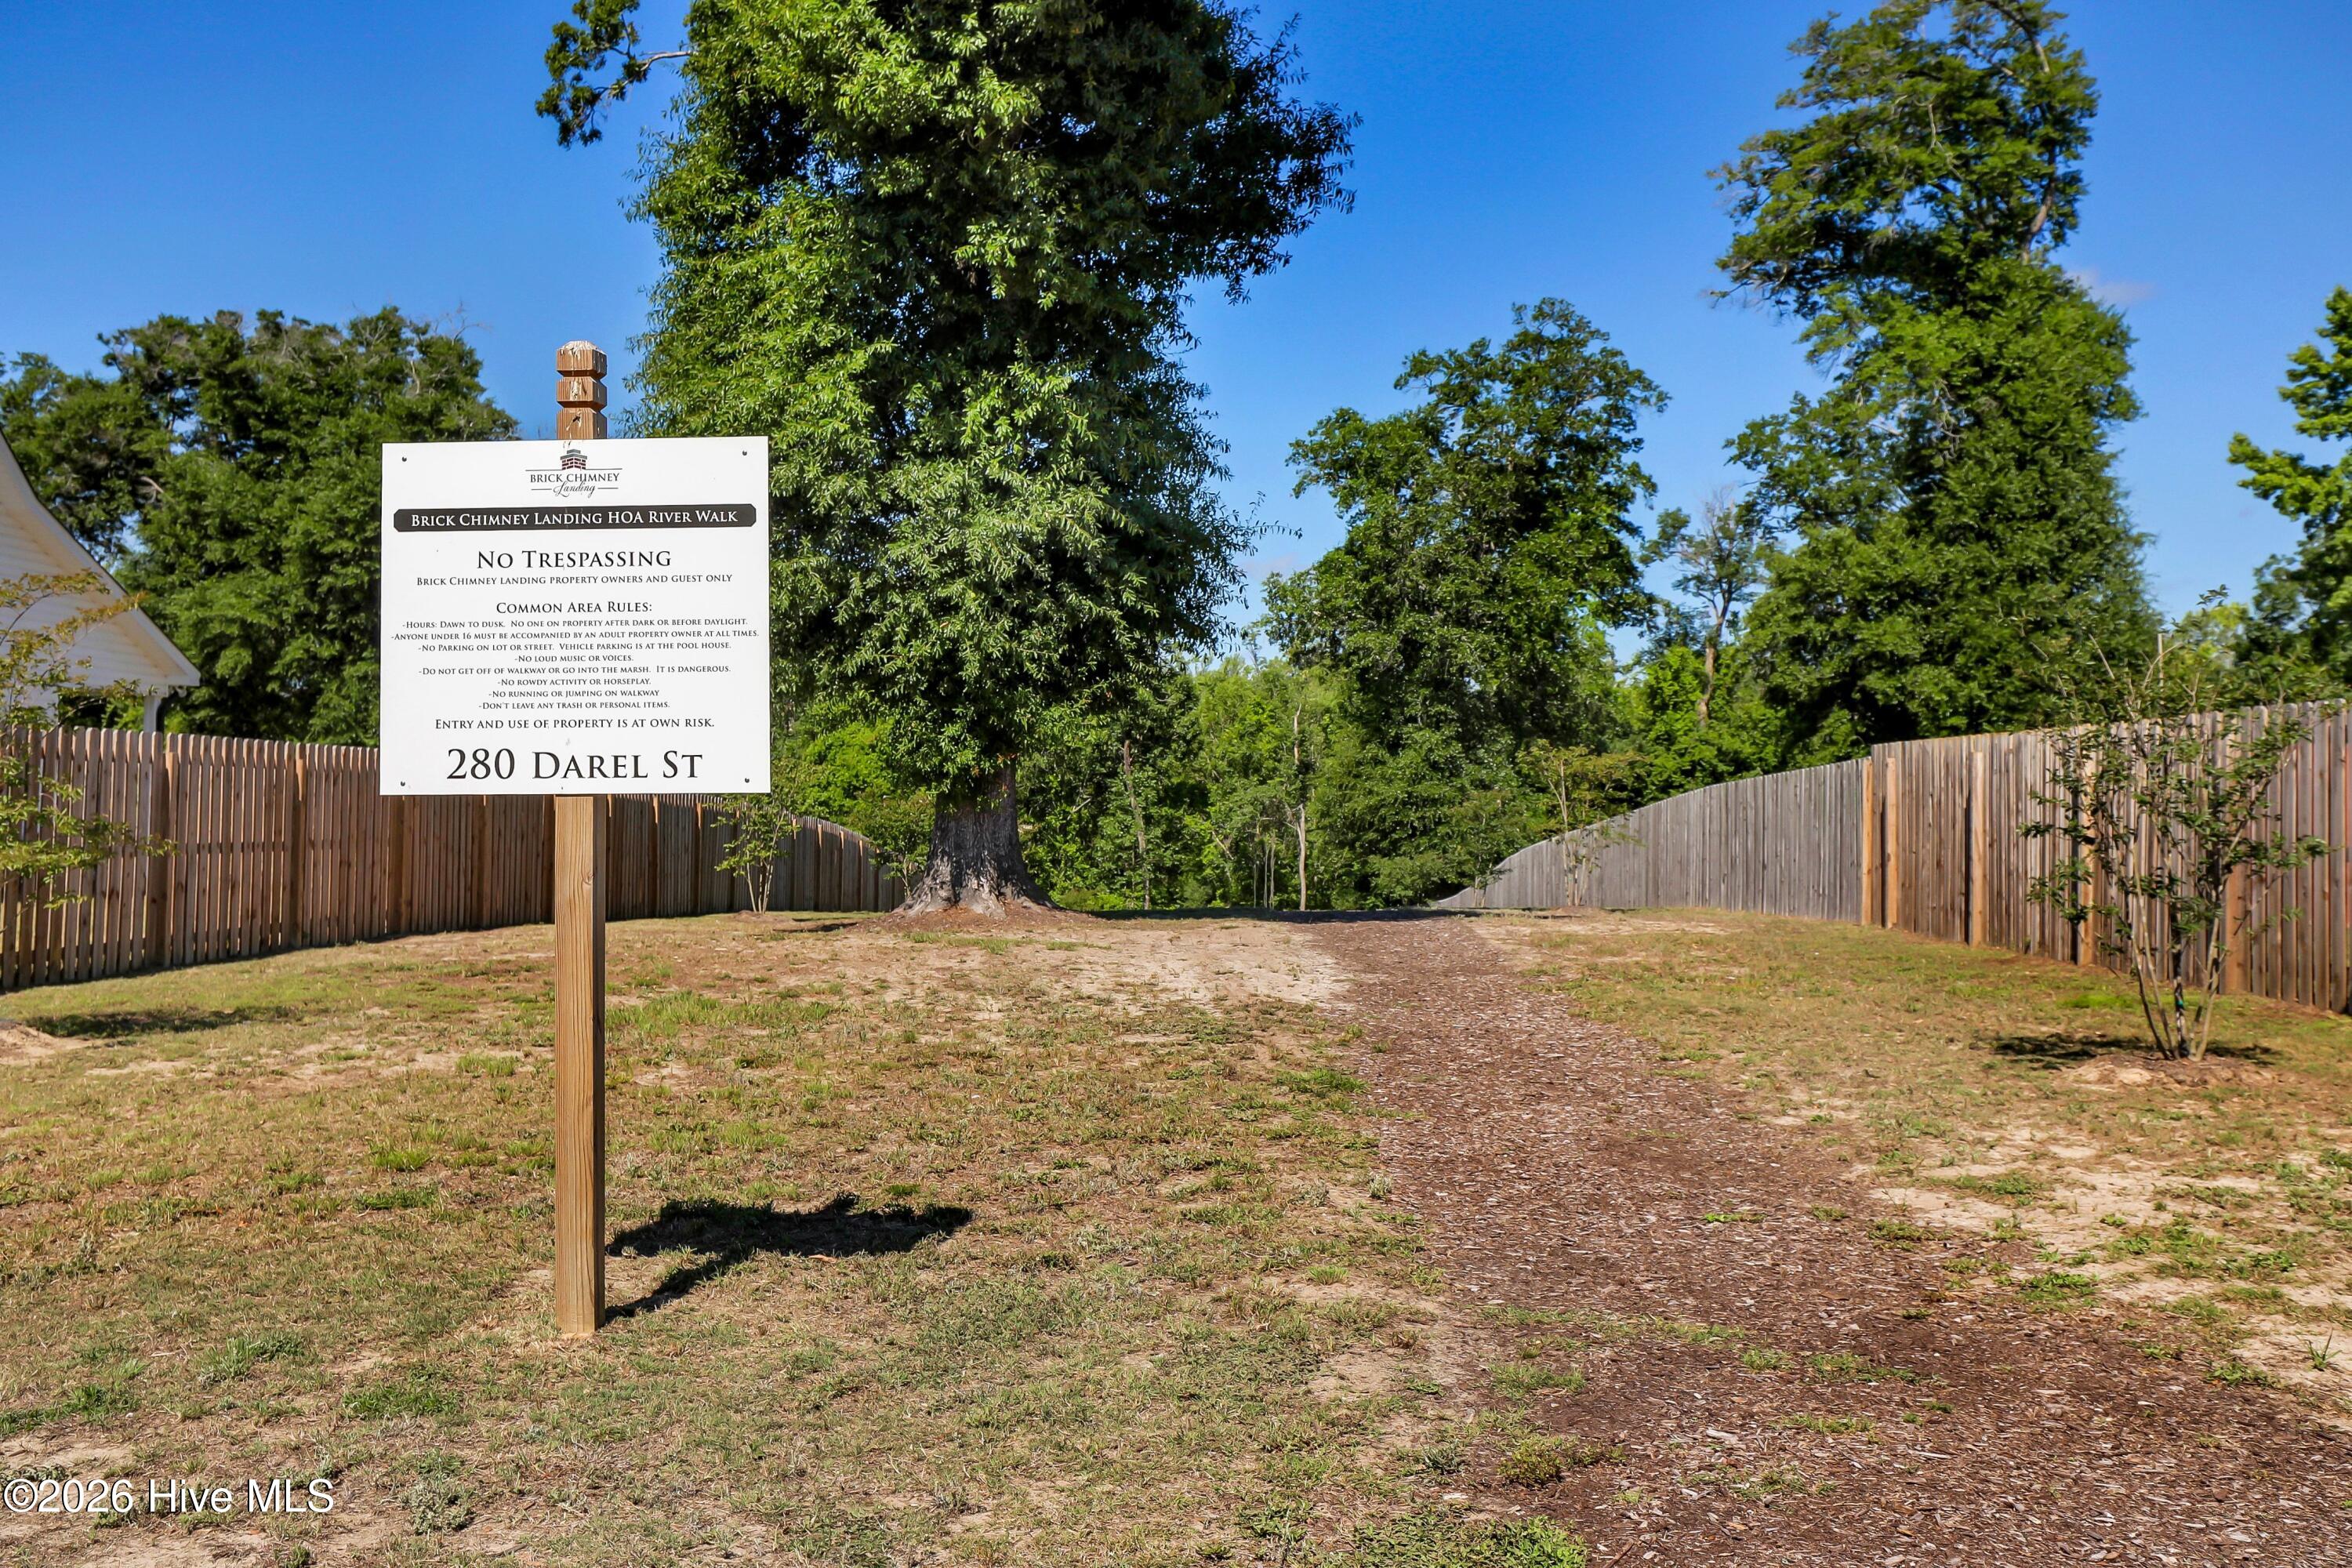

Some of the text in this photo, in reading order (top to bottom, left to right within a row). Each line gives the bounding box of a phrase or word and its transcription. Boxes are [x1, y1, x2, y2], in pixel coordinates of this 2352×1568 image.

[530, 473, 619, 483] BRICK CHIMNEY
[553, 480, 596, 498] Landing
[412, 510, 739, 527] BRICK CHIMNEY LANDING HOA RIVER WALK
[477, 550, 672, 569] NO TRESPASSING
[496, 602, 562, 614] COMMON
[567, 601, 602, 613] AREA
[435, 719, 474, 729] ENTRY
[477, 720, 504, 729] AND
[508, 720, 529, 729] USE
[533, 719, 550, 728] OF
[554, 719, 613, 728] PROPERTY
[617, 719, 628, 728] IS
[631, 718, 647, 728] AT
[650, 718, 680, 728] OWN
[446, 748, 703, 780] 280 DAREL ST
